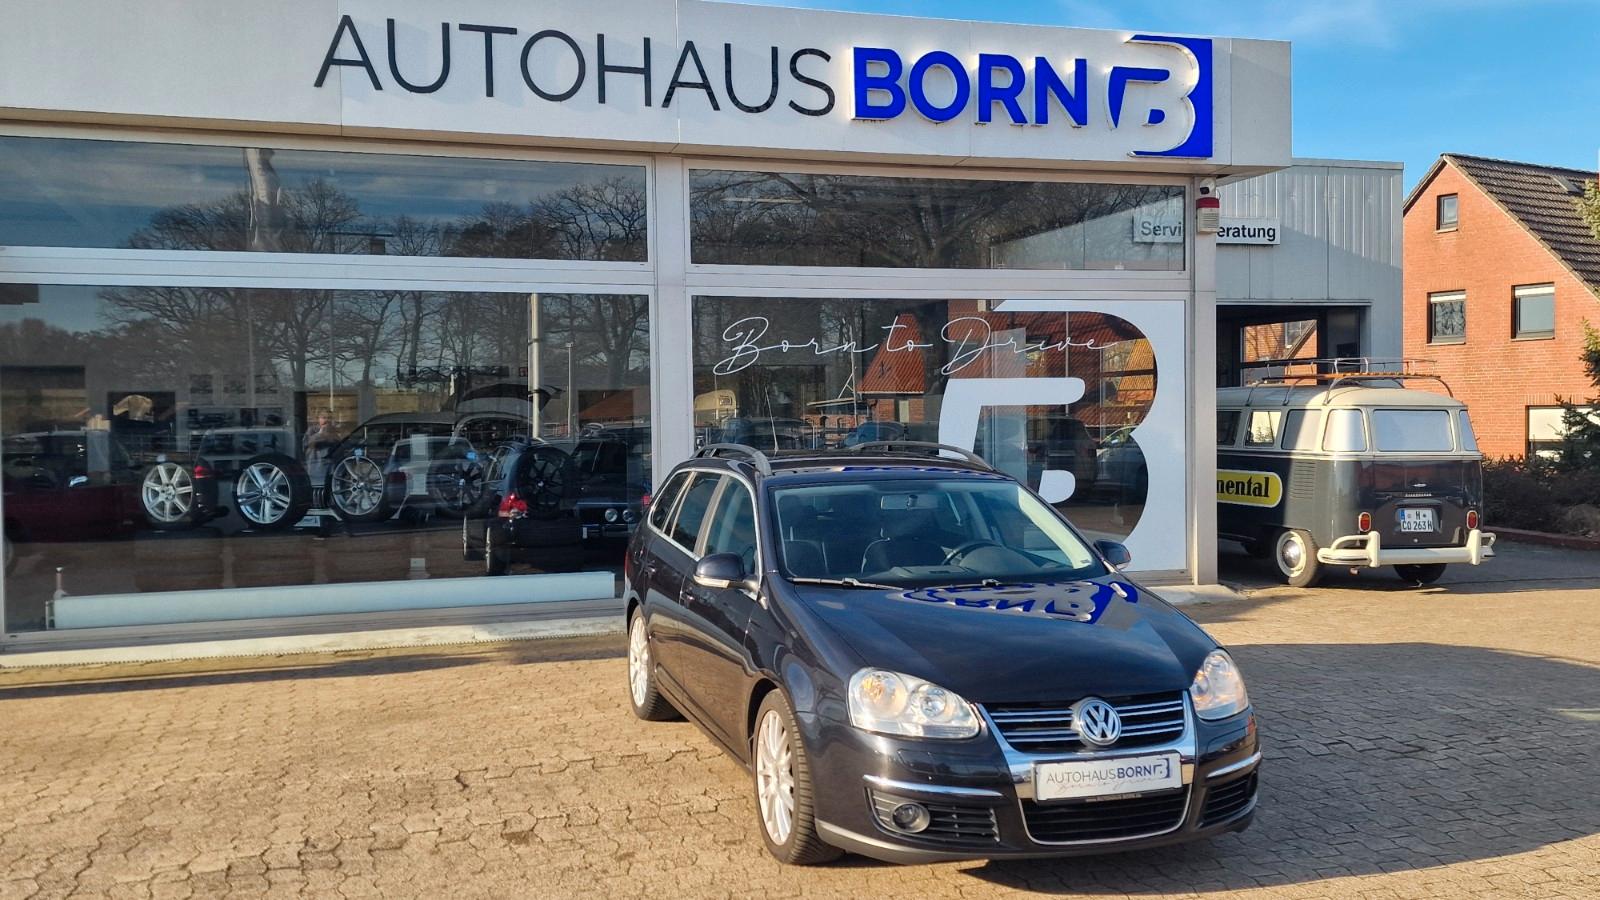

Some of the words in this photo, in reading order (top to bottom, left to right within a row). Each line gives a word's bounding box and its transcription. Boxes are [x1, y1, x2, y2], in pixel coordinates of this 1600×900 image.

[314, 14, 836, 117] AUTOHAUS
[852, 46, 1089, 127] BORN
[1216, 224, 1276, 242] eratung
[712, 316, 878, 375] Born
[881, 315, 934, 351] to
[940, 316, 1119, 375] Drive
[1216, 475, 1270, 498] nental
[1117, 764, 1152, 779] BORN
